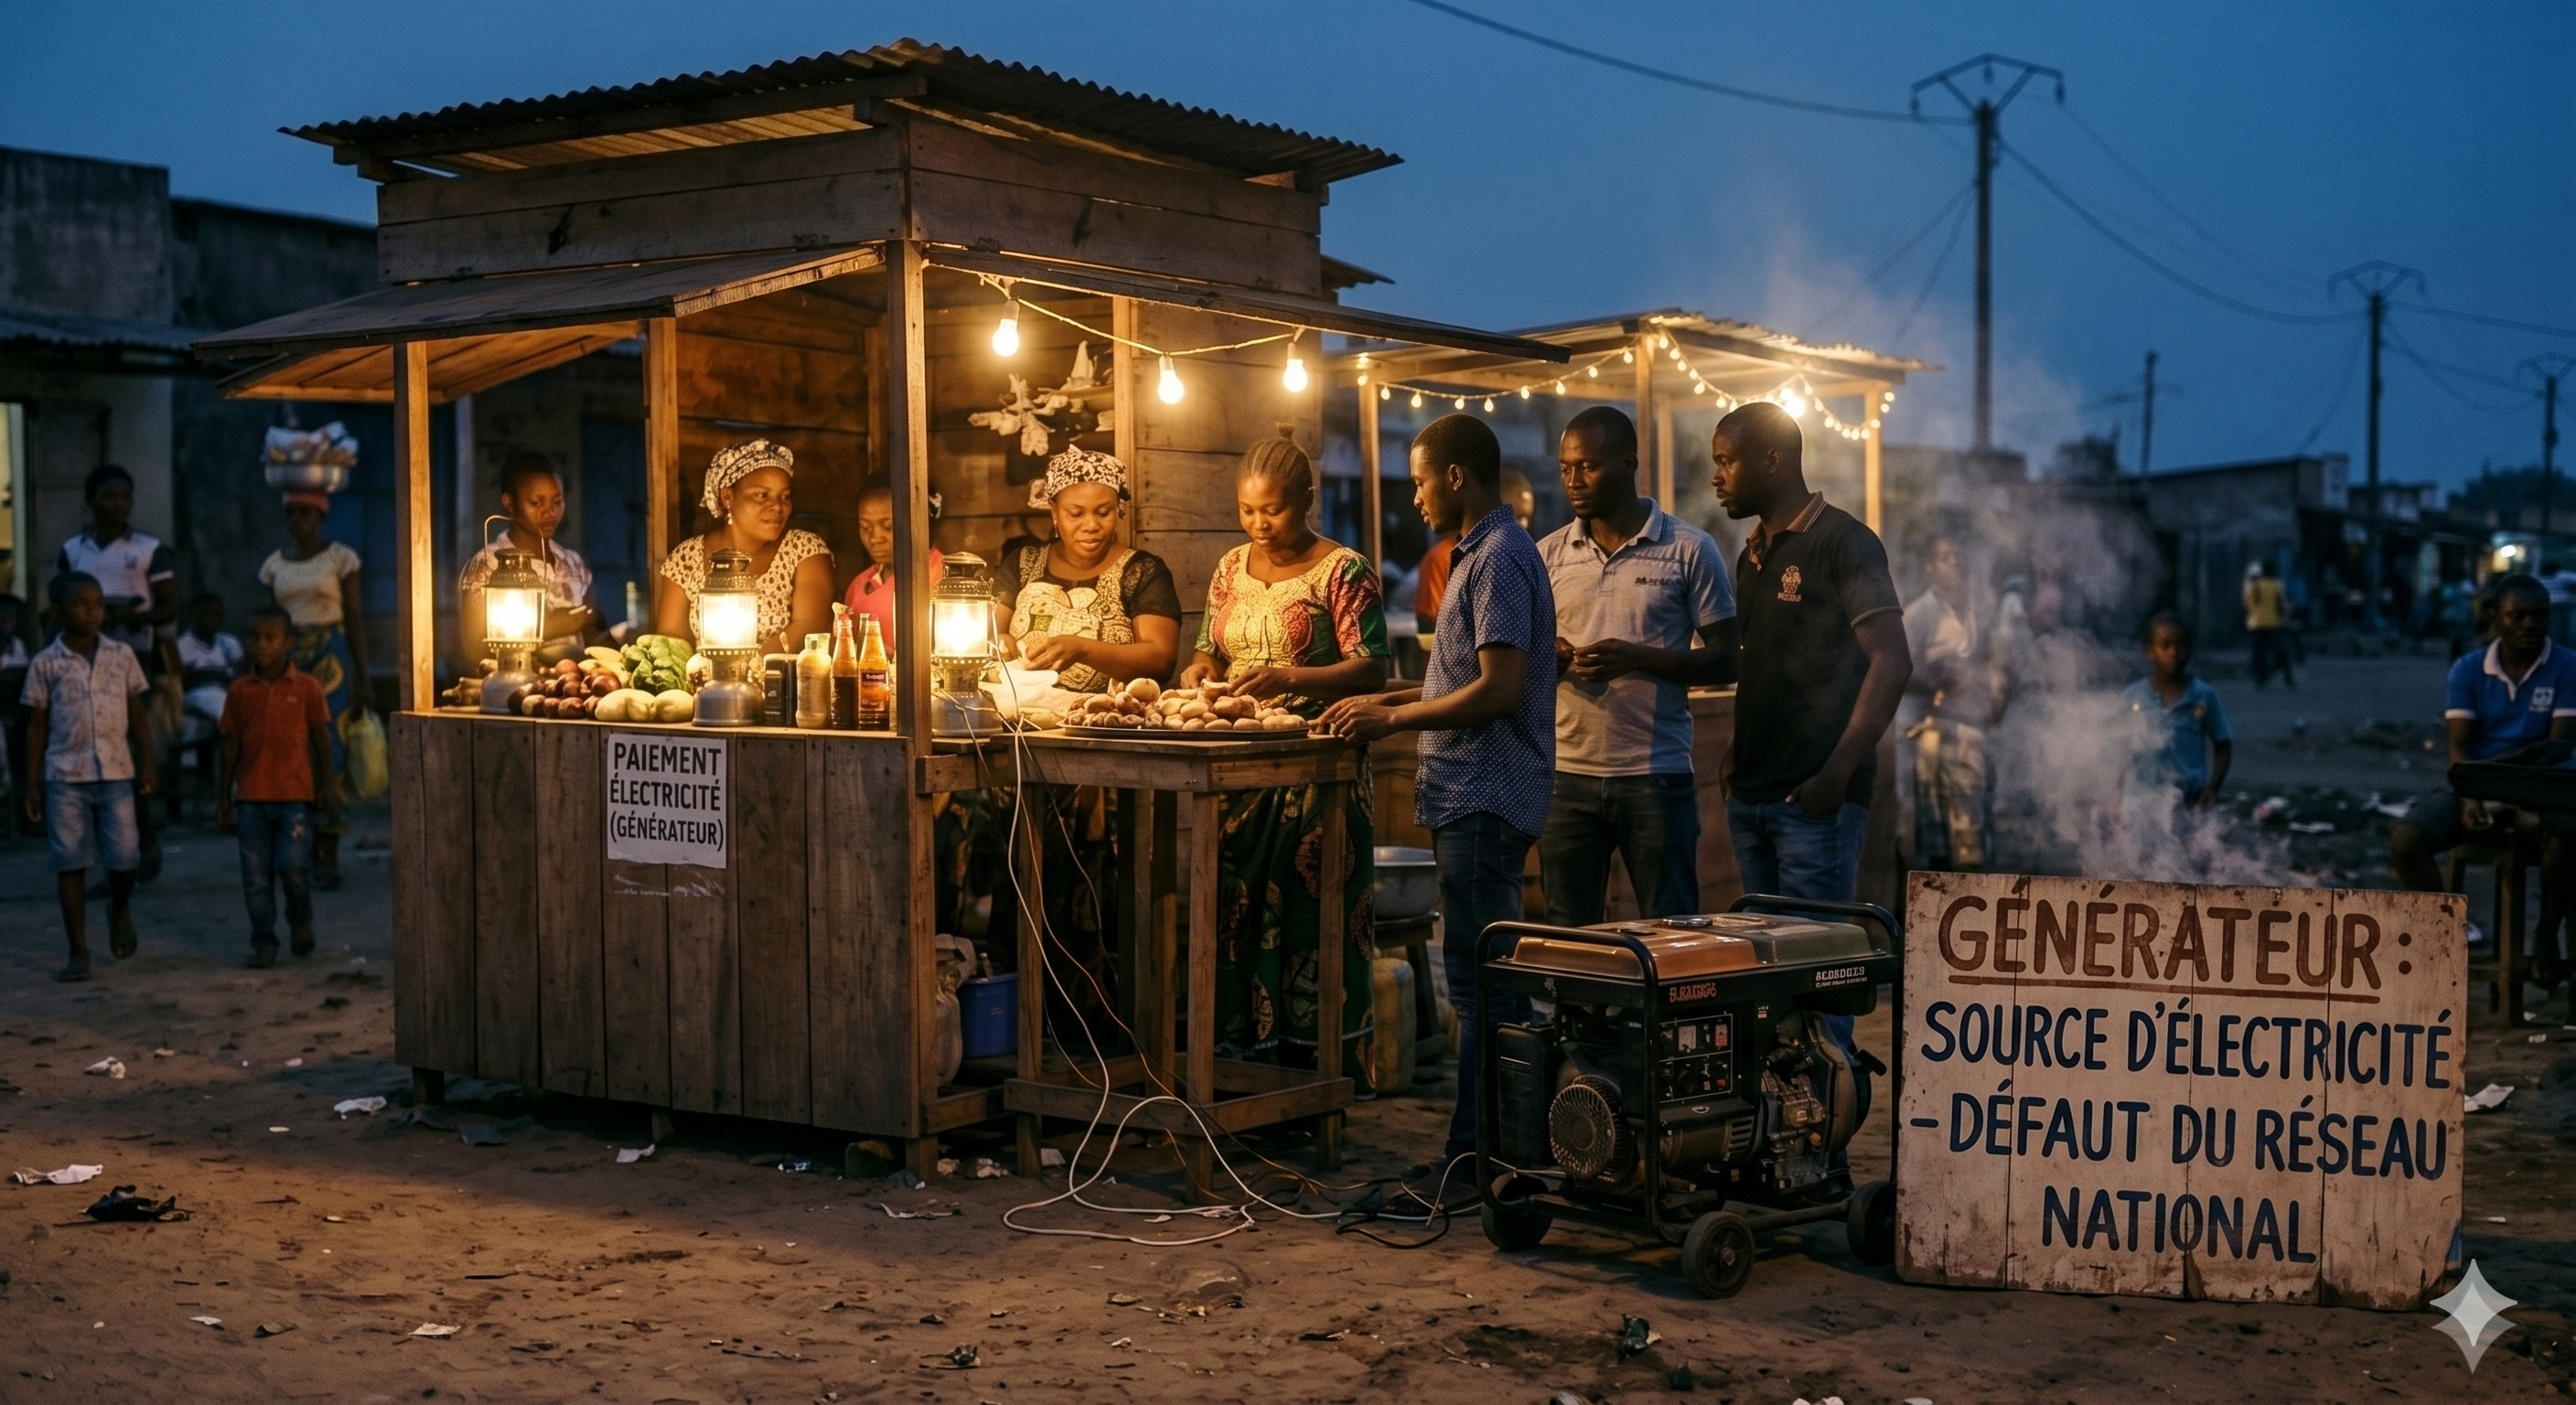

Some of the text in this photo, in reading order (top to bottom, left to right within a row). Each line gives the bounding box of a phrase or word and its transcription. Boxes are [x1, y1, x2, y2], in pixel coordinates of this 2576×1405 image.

[615, 742, 721, 776] PAIEMENT
[610, 772, 721, 811] ÉLECTRICITÉ
[610, 810, 724, 853] (GÉNÉRATEUR)
[1921, 997, 2452, 1089] SOURCE D'ÉLECTRICITÉ
[2172, 1104, 2238, 1167] DU
[2255, 1095, 2448, 1181] RÉSEAU
[2042, 1185, 2317, 1264] NATIONAL
